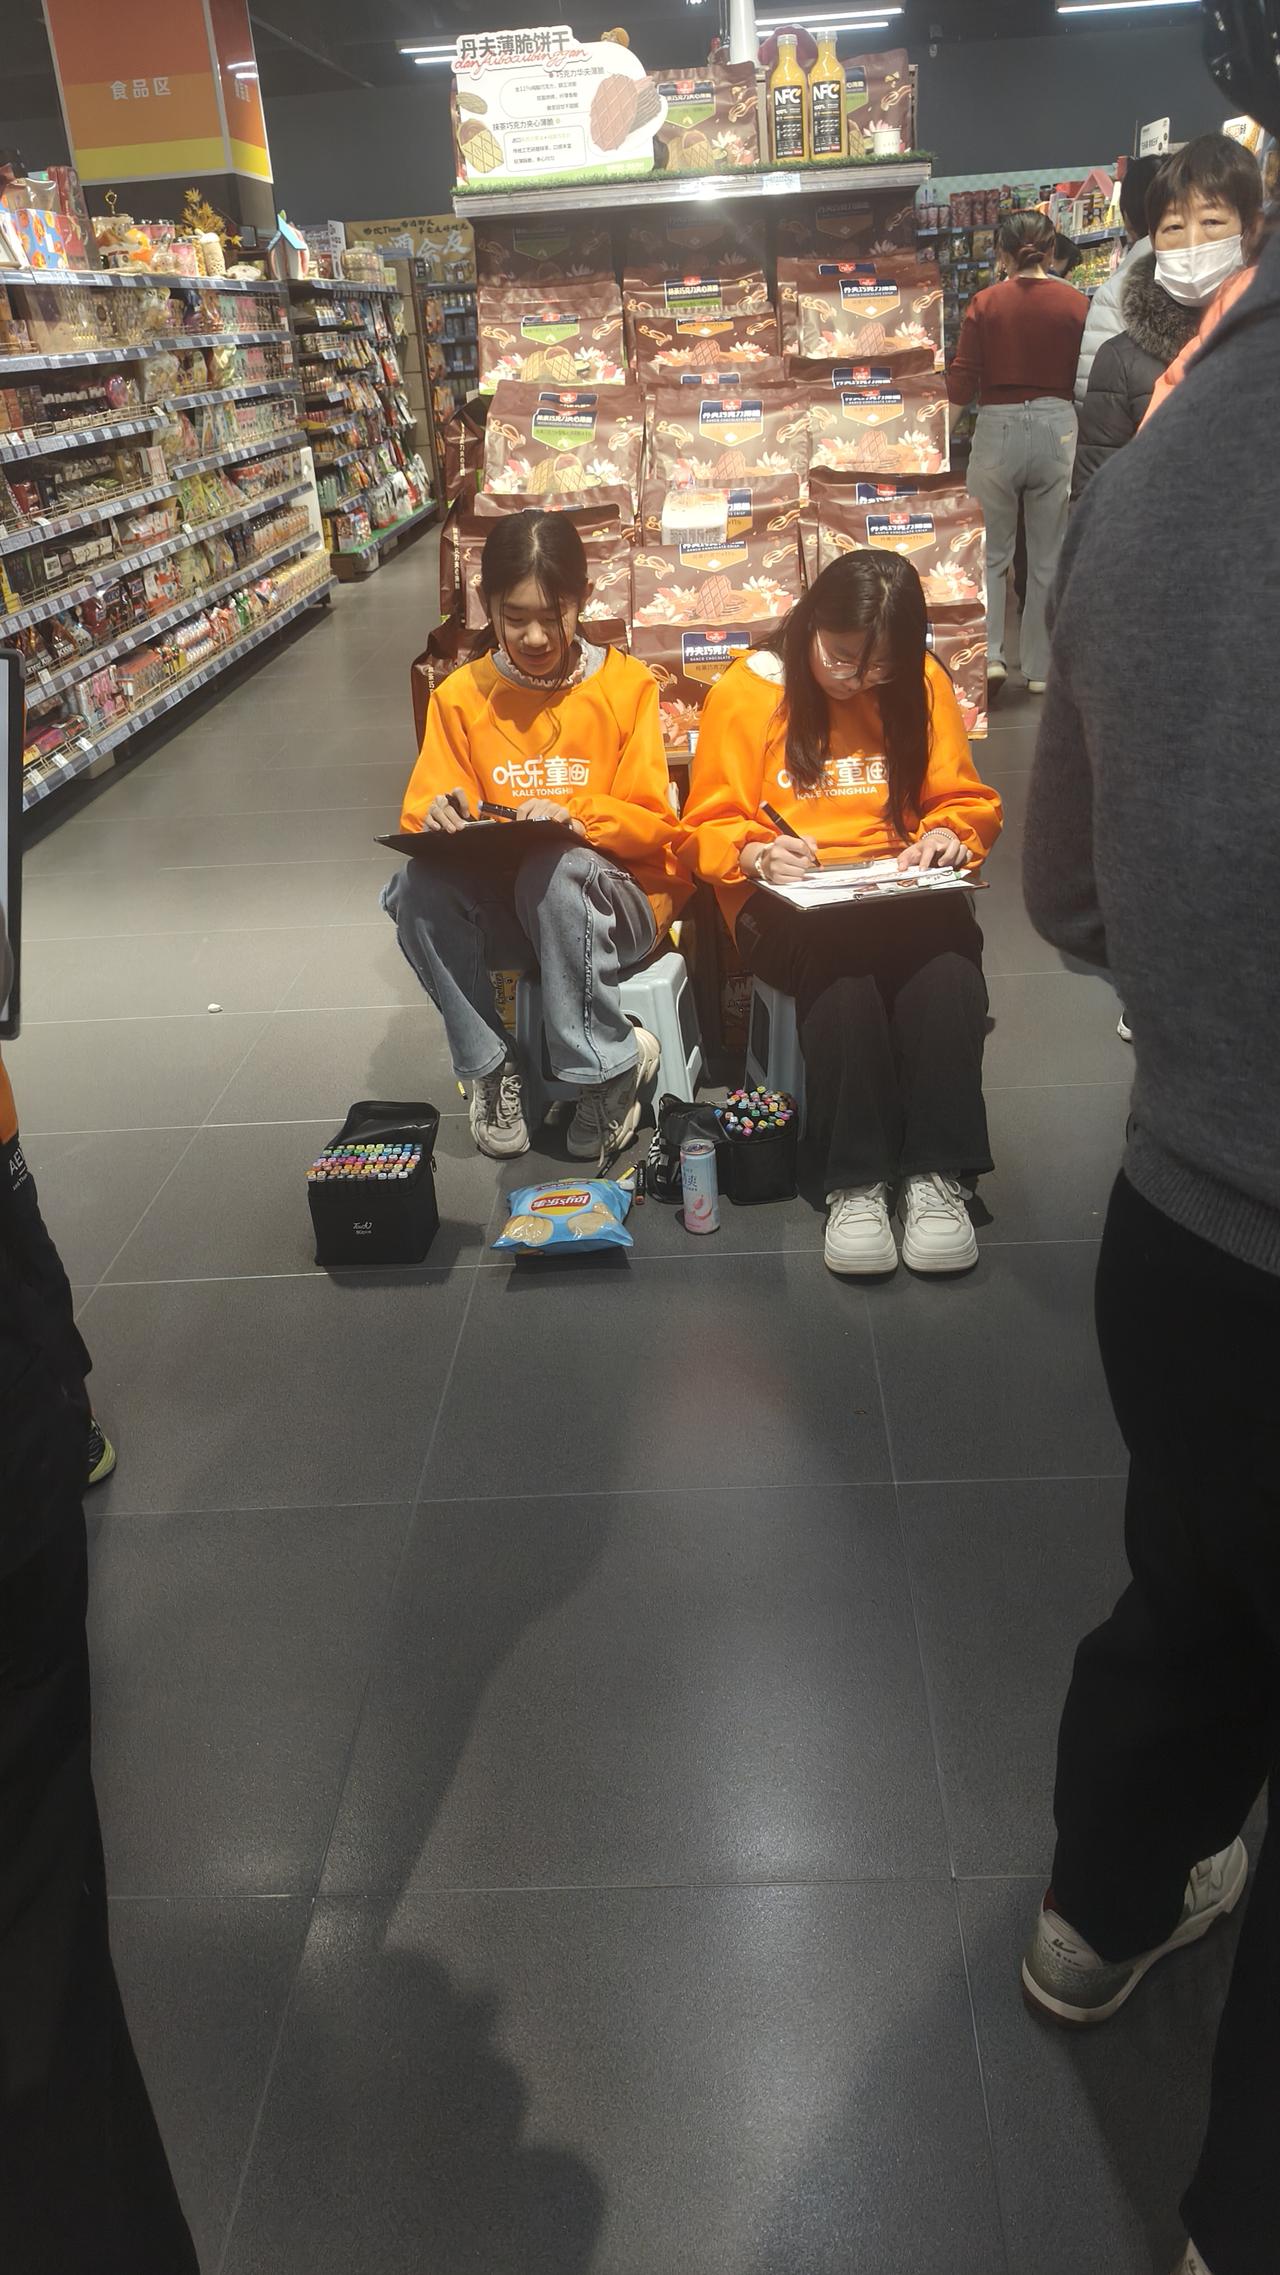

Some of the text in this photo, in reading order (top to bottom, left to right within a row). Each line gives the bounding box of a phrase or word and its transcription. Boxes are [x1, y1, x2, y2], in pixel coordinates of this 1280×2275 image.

[460, 30, 570, 59] 丹夫薄脆饼干
[110, 76, 172, 100] 食品区
[774, 88, 801, 106] NFC
[813, 83, 839, 101] NFC
[493, 754, 591, 788] 咔乐童画
[512, 788, 535, 797] KALE
[824, 786, 878, 797] TONGHUA
